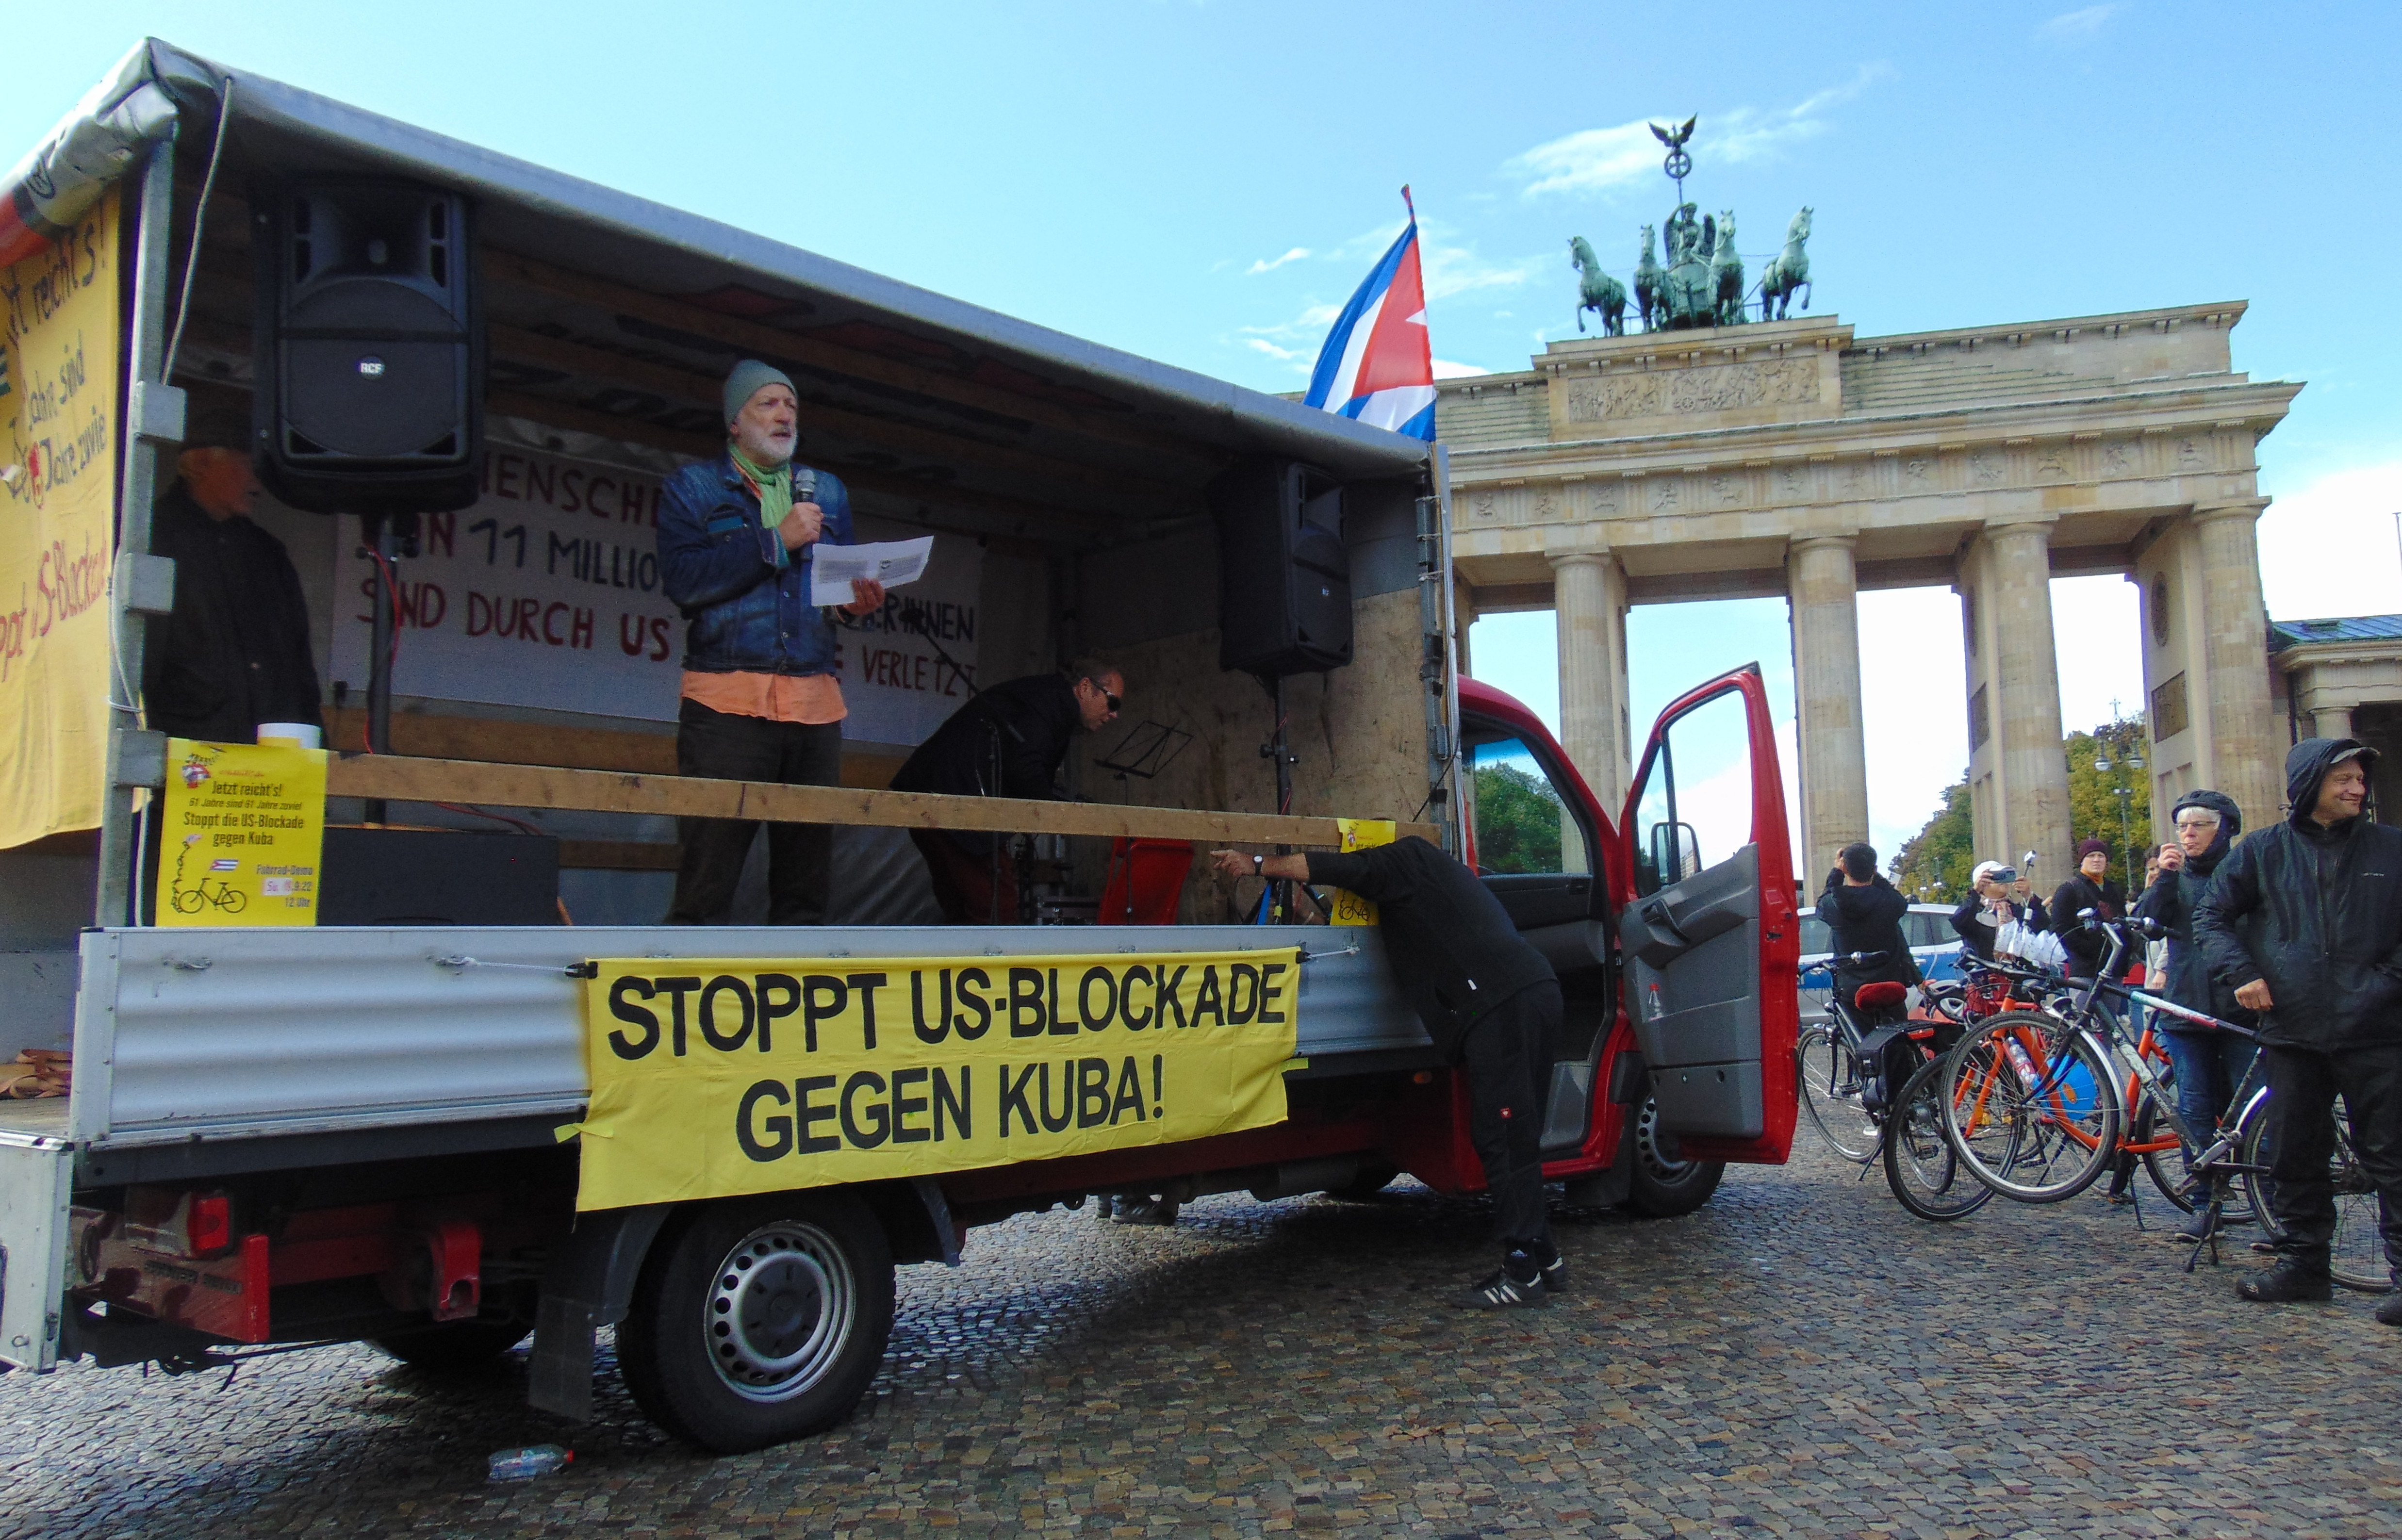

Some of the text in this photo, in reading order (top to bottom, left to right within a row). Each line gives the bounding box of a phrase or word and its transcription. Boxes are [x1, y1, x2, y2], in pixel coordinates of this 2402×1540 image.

[481, 450, 663, 528] ENSCH
[469, 518, 526, 568] 11
[548, 531, 658, 592] MILLIO
[466, 591, 593, 649] DURCH
[862, 645, 975, 699] VERLETZT
[200, 798, 224, 808] Jahre
[225, 800, 243, 809] sind
[256, 801, 279, 810] Jahre
[212, 780, 282, 797] Jetzt reicht's!
[183, 812, 304, 829] Stoppt die US-Blockade
[212, 832, 274, 848] gegen Kuba
[297, 898, 311, 908] Uhr
[608, 963, 1287, 1061] STOPPT US-BLOCKADE
[736, 1054, 1164, 1163] GEGEN KUBA!
